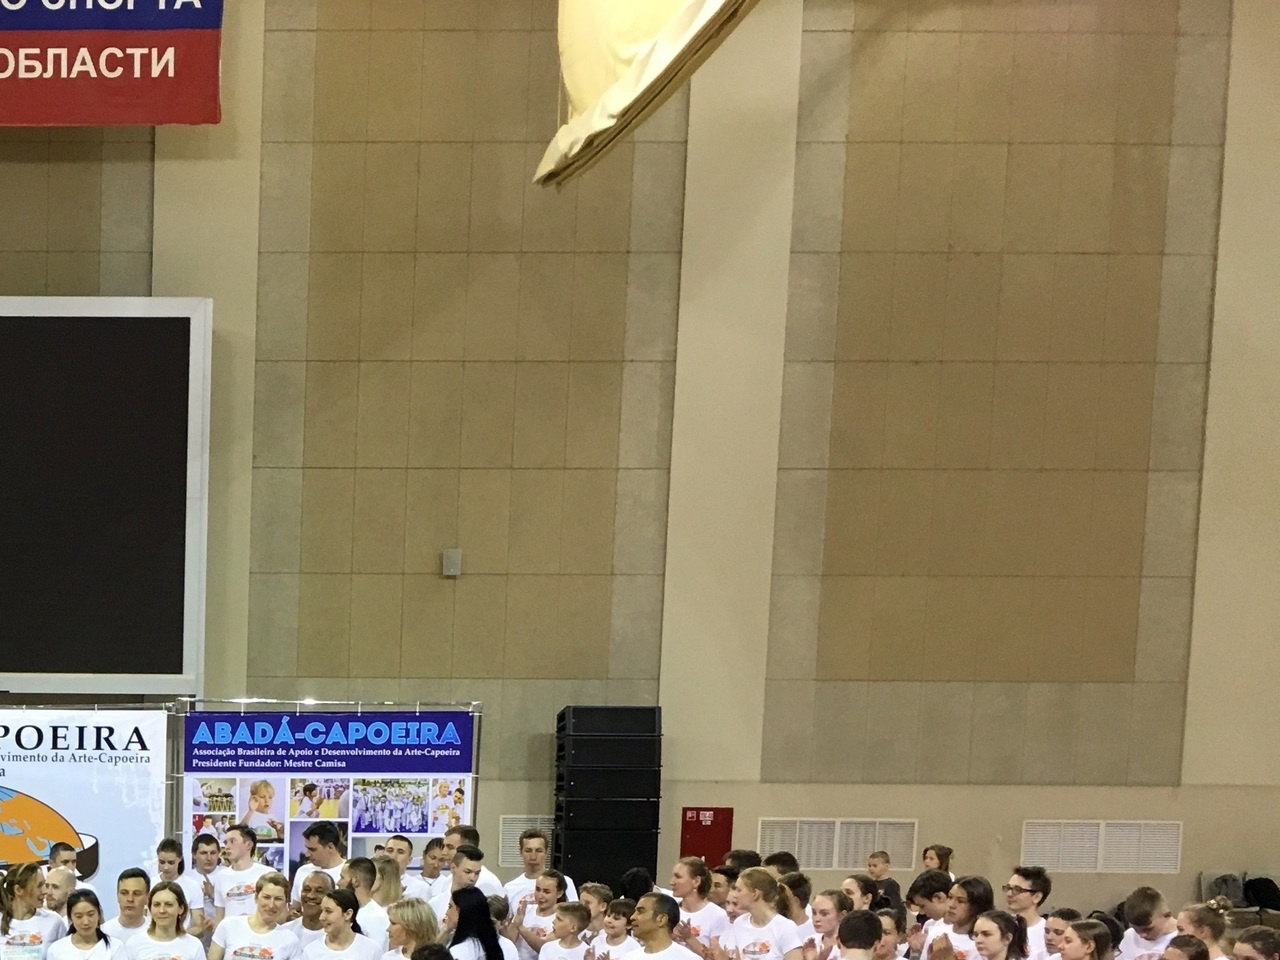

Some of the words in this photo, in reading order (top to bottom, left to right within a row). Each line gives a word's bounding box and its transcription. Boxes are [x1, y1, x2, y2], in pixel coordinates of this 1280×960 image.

[192, 715, 461, 745] ABADÁ-CAPOEIRA
[192, 747, 236, 757] Associação
[237, 747, 275, 756] Brasileira
[276, 748, 286, 756] de
[288, 748, 313, 758] Apoio
[321, 748, 391, 756] Desenvolvimento
[393, 748, 403, 756] da
[404, 748, 461, 758] Arte-Capoeira
[51, 752, 65, 763] da
[69, 752, 151, 766] Arte-Capoeira
[192, 759, 237, 768] Presidente
[238, 759, 282, 768] Fundador:
[283, 759, 313, 768] Mestre
[314, 759, 347, 768] Camisa
